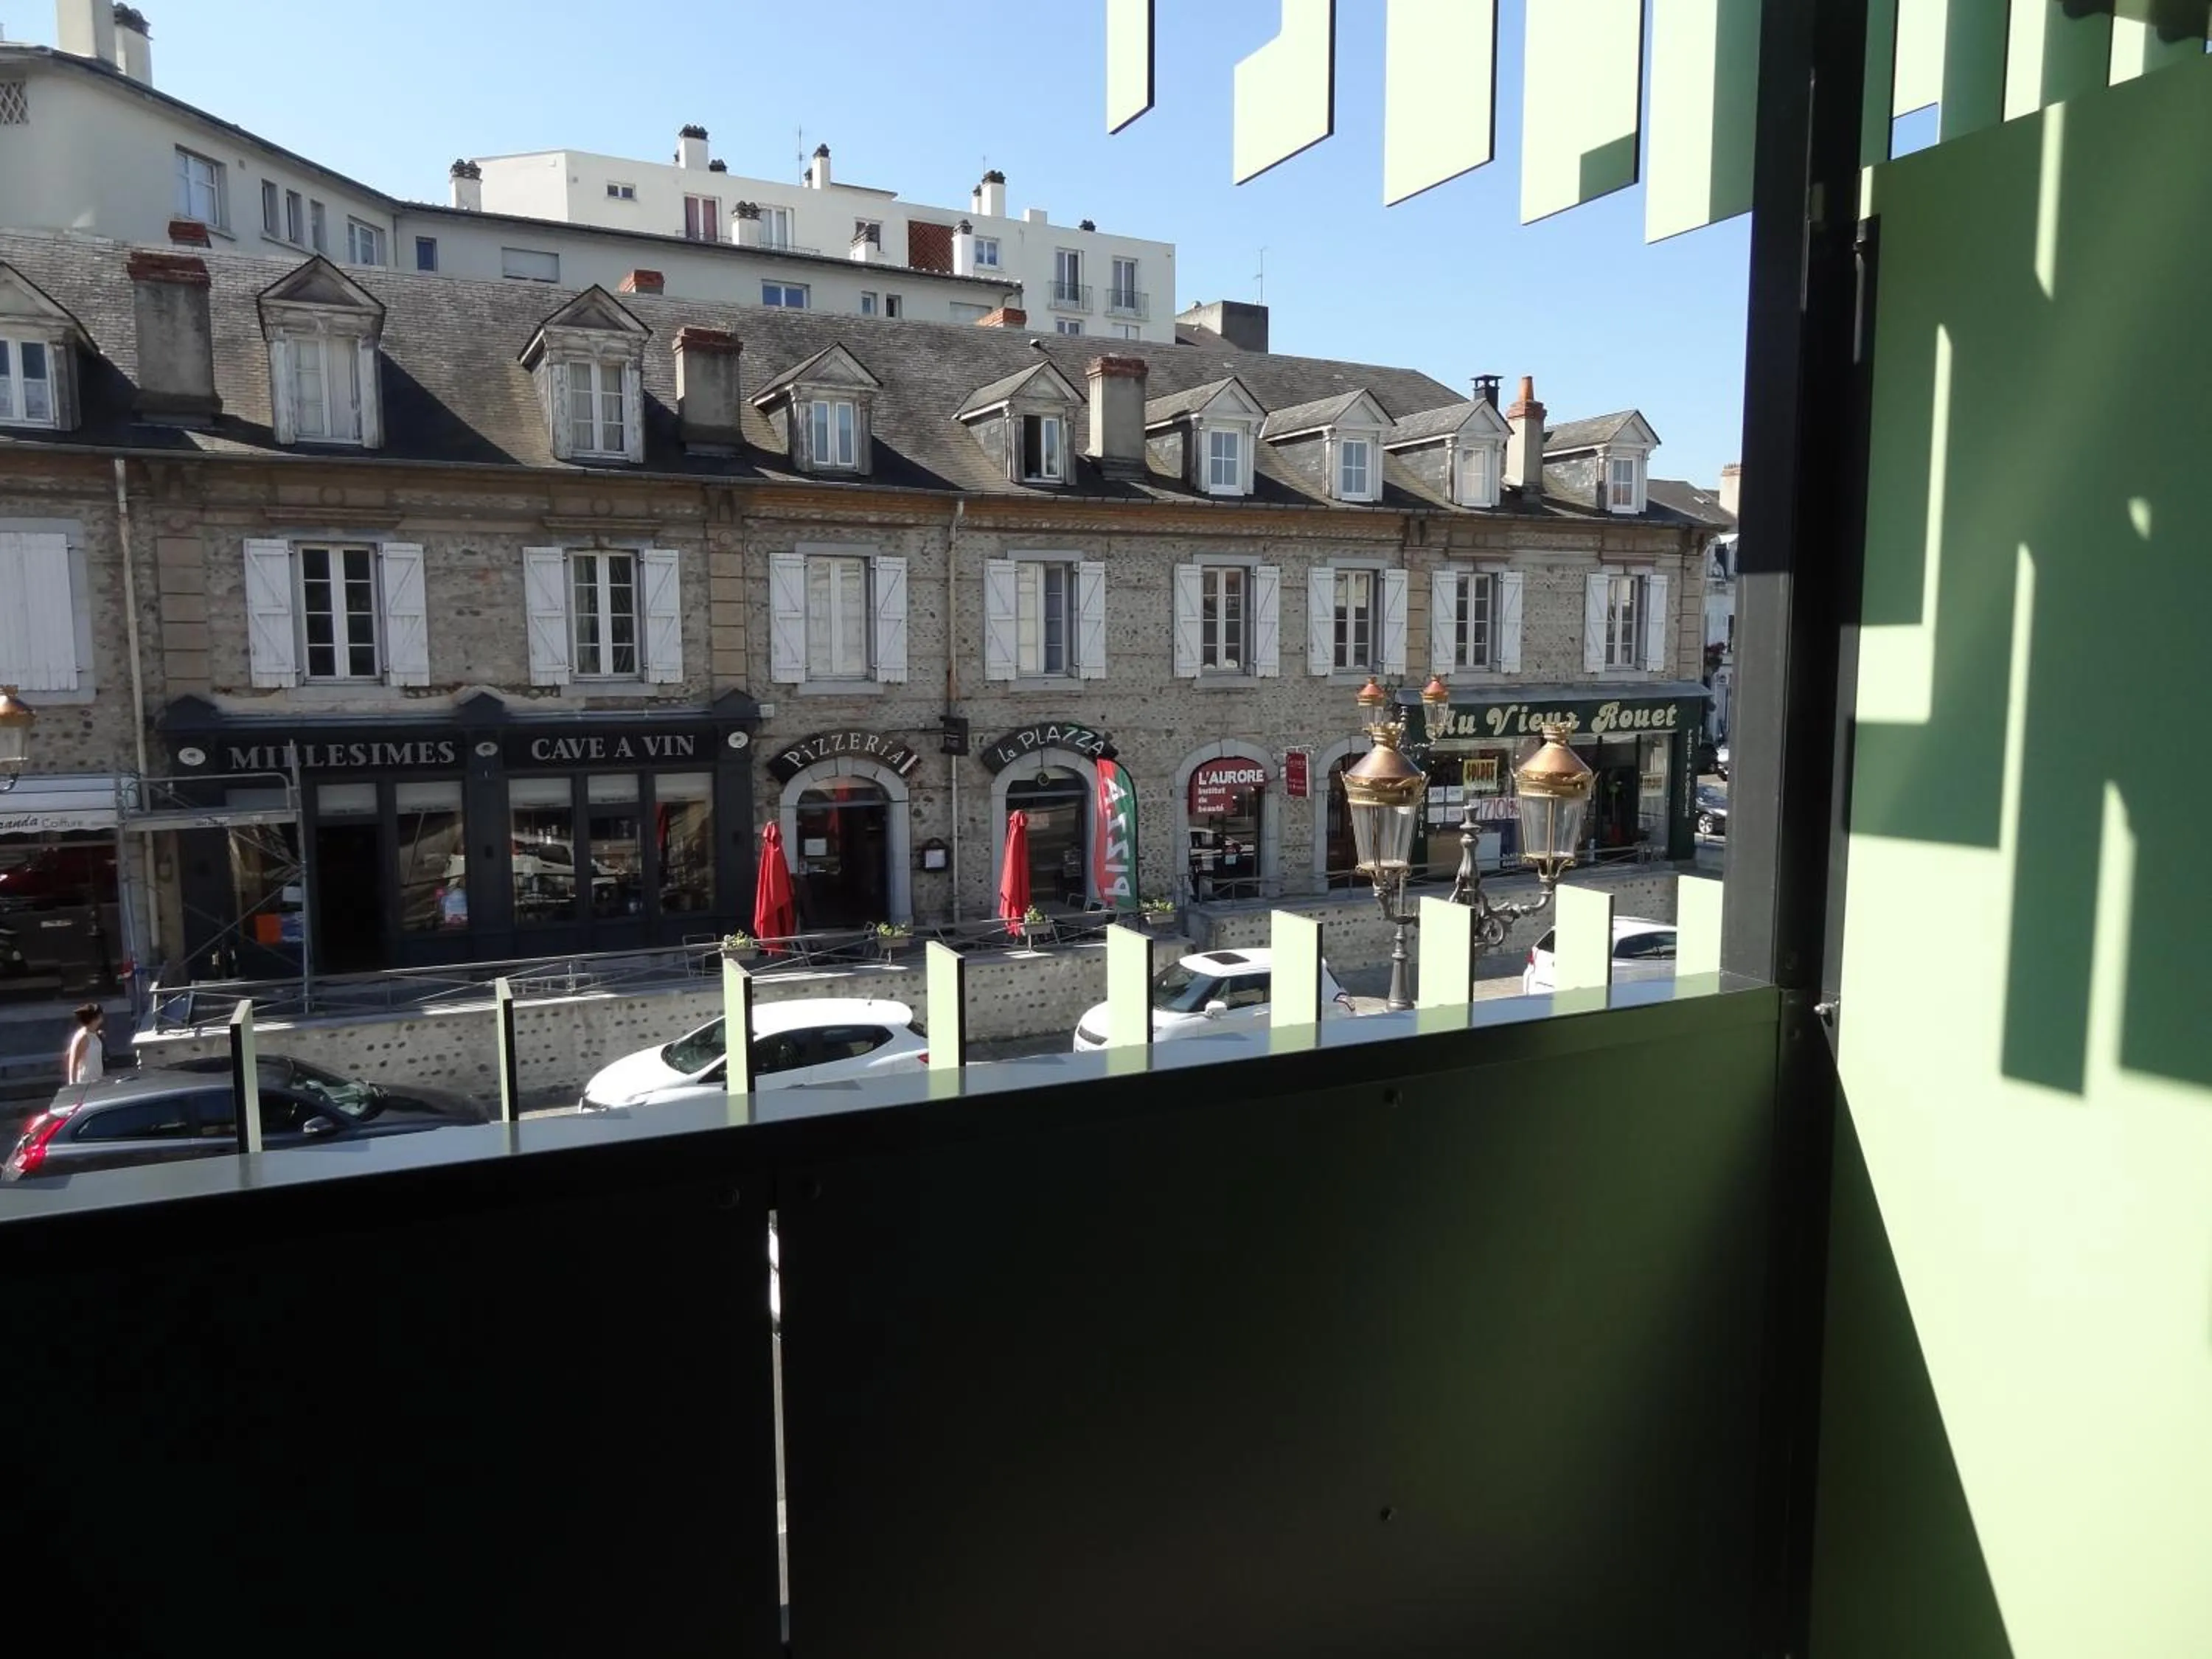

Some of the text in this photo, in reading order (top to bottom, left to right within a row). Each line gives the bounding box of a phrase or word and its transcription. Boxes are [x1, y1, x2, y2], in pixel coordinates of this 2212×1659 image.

[1591, 701, 1677, 733] Rouet
[531, 735, 695, 760] CAVE A VIN
[1198, 769, 1264, 785] L'AURORE
[1105, 778, 1130, 897] PIZZA
